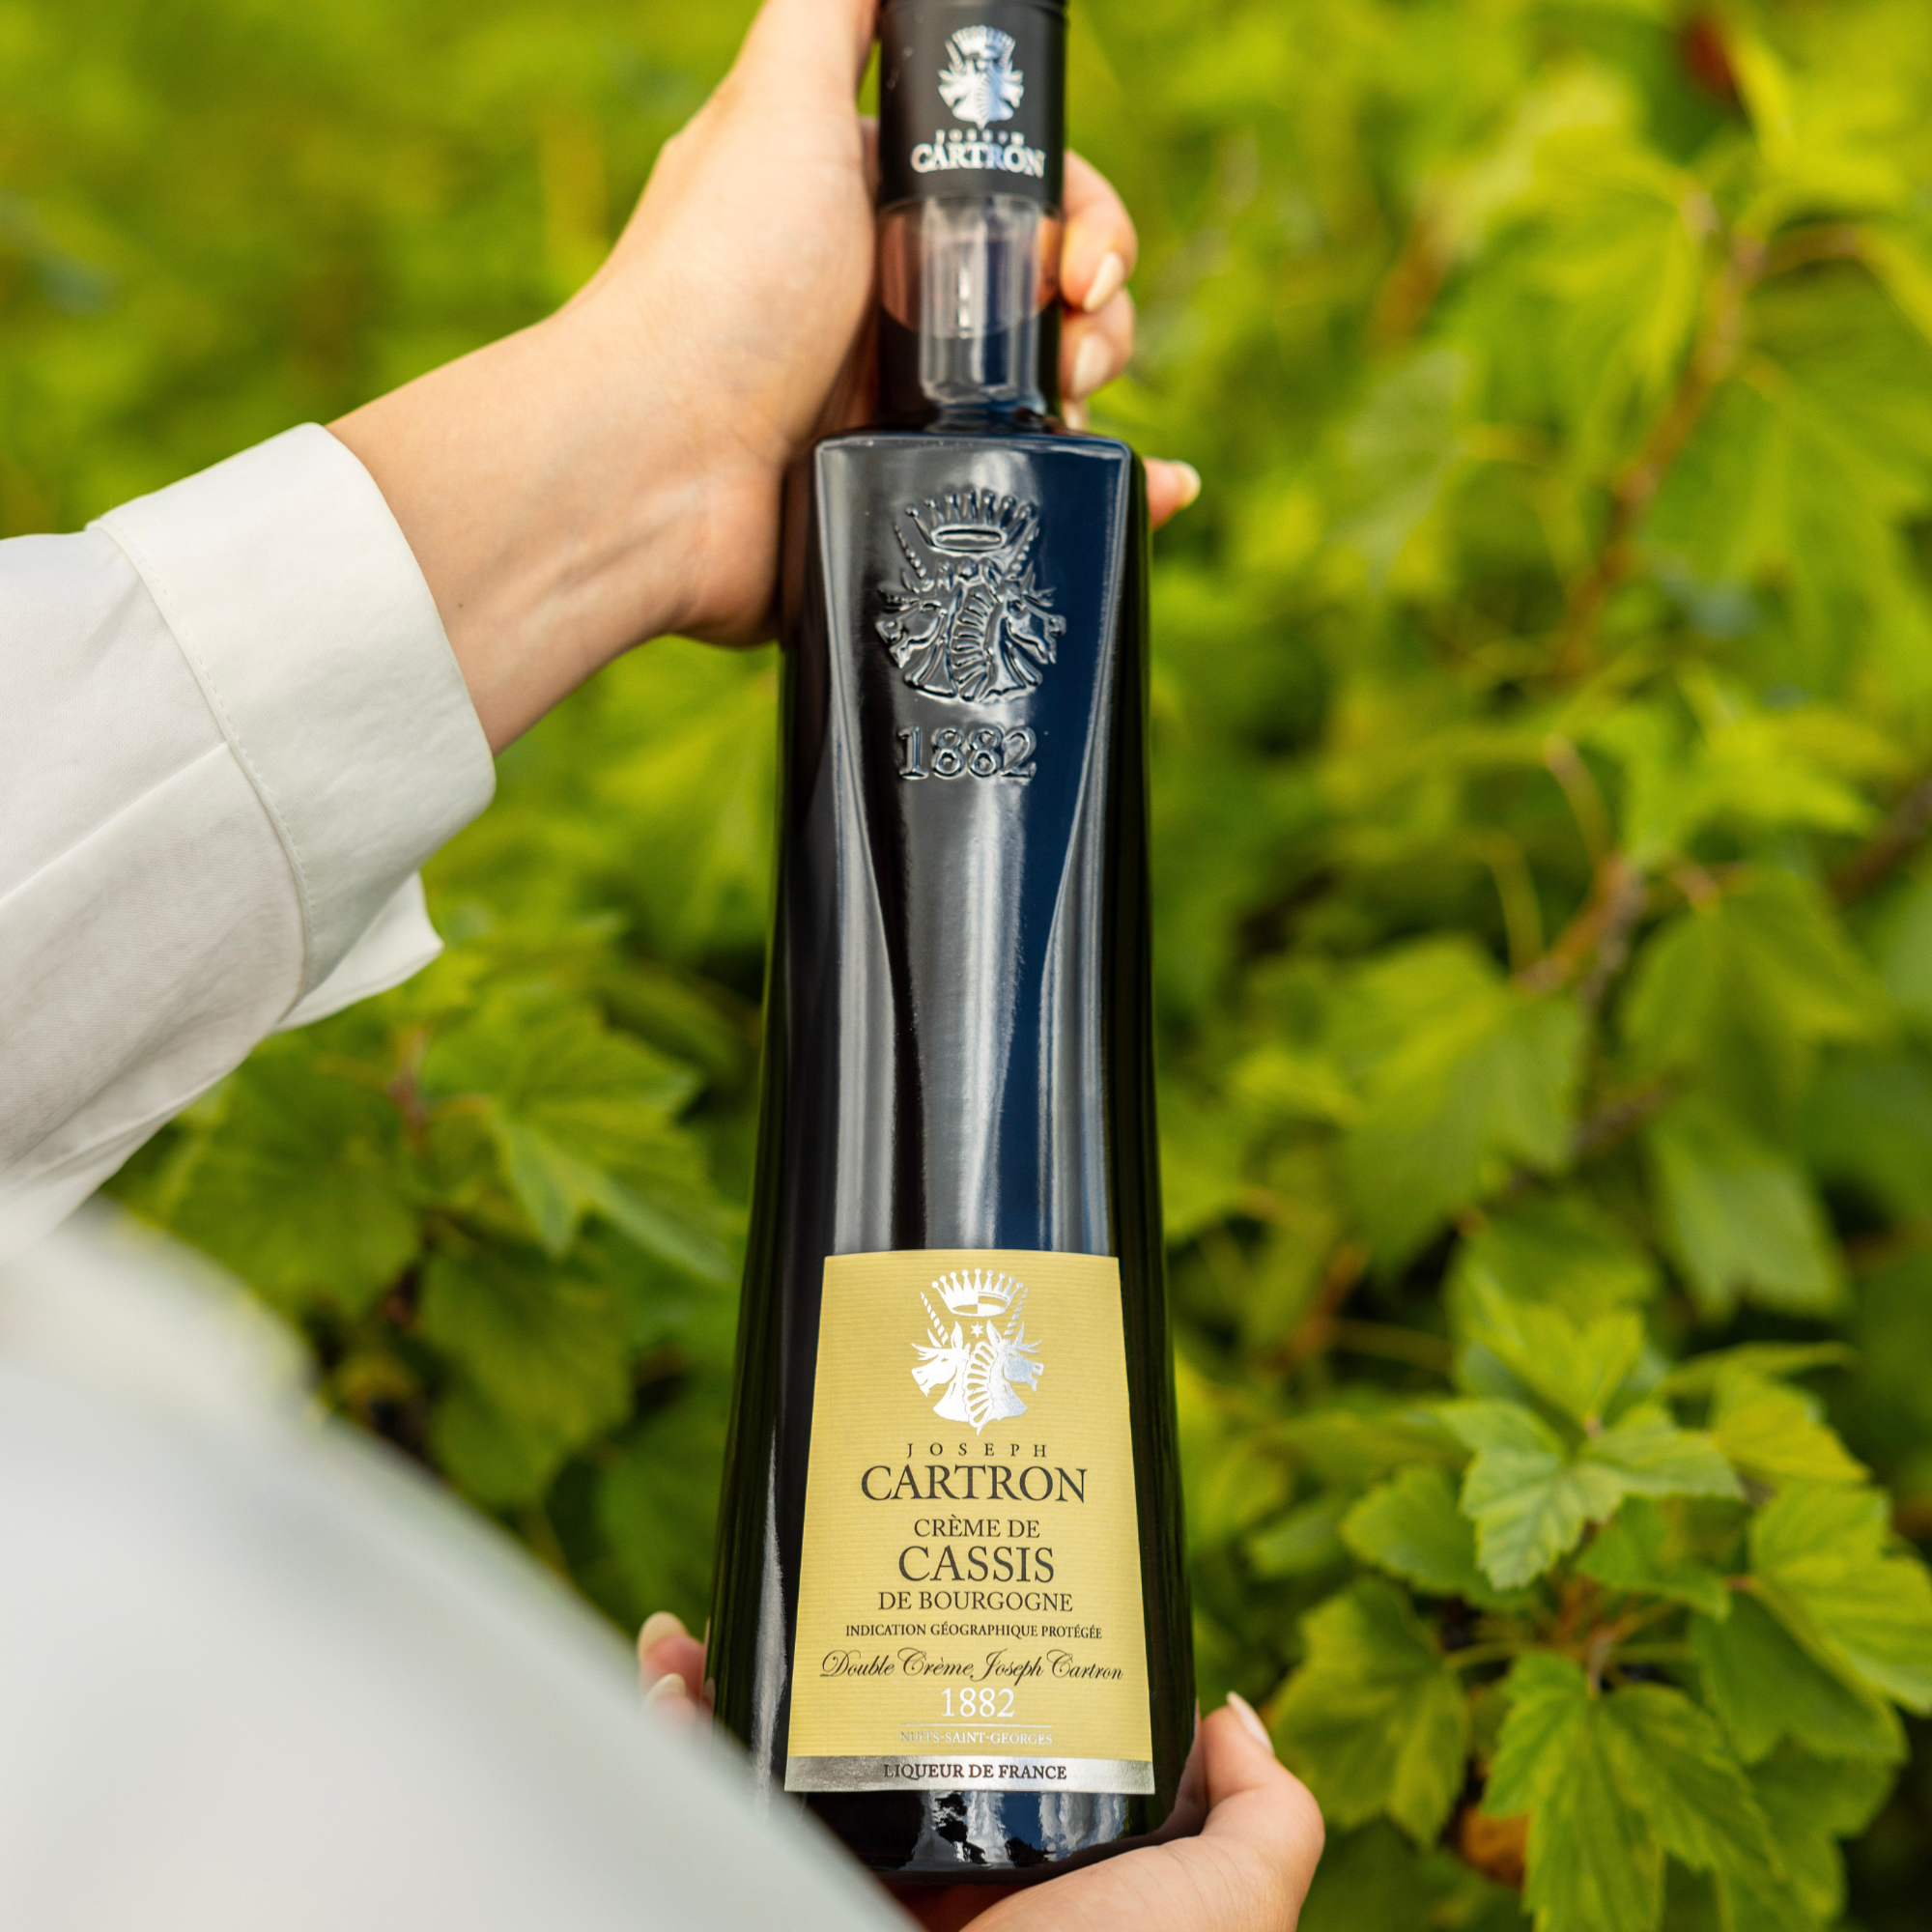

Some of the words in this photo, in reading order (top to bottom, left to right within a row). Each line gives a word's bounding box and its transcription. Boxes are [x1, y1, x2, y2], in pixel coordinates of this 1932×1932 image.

[910, 142, 1046, 179] CARTRON
[896, 725, 1037, 781] 1882
[907, 1442, 1047, 1459] JOSEPH
[861, 1463, 1088, 1504] CARTRON
[914, 1514, 1001, 1538] CRÈME
[1007, 1520, 1040, 1538] DE
[898, 1545, 1055, 1583] CASSIS
[878, 1591, 912, 1610] DE
[919, 1591, 1073, 1612] BOURGOGNE
[846, 1624, 926, 1636] INDICATION
[930, 1621, 1038, 1640] GÉOGRAPHIQUE
[1041, 1624, 1103, 1639] PROTÉGÉE
[820, 1648, 895, 1678] Double
[897, 1647, 975, 1677] Crème
[969, 1648, 1044, 1687] Joseph
[1046, 1648, 1124, 1680] Cartron
[941, 1687, 1015, 1718] 1882
[899, 1731, 1053, 1746] NUITS-SAINT-GEORGES
[884, 1763, 965, 1780] LIQUEUR
[969, 1764, 994, 1778] DE
[999, 1764, 1067, 1780] FRANCE
